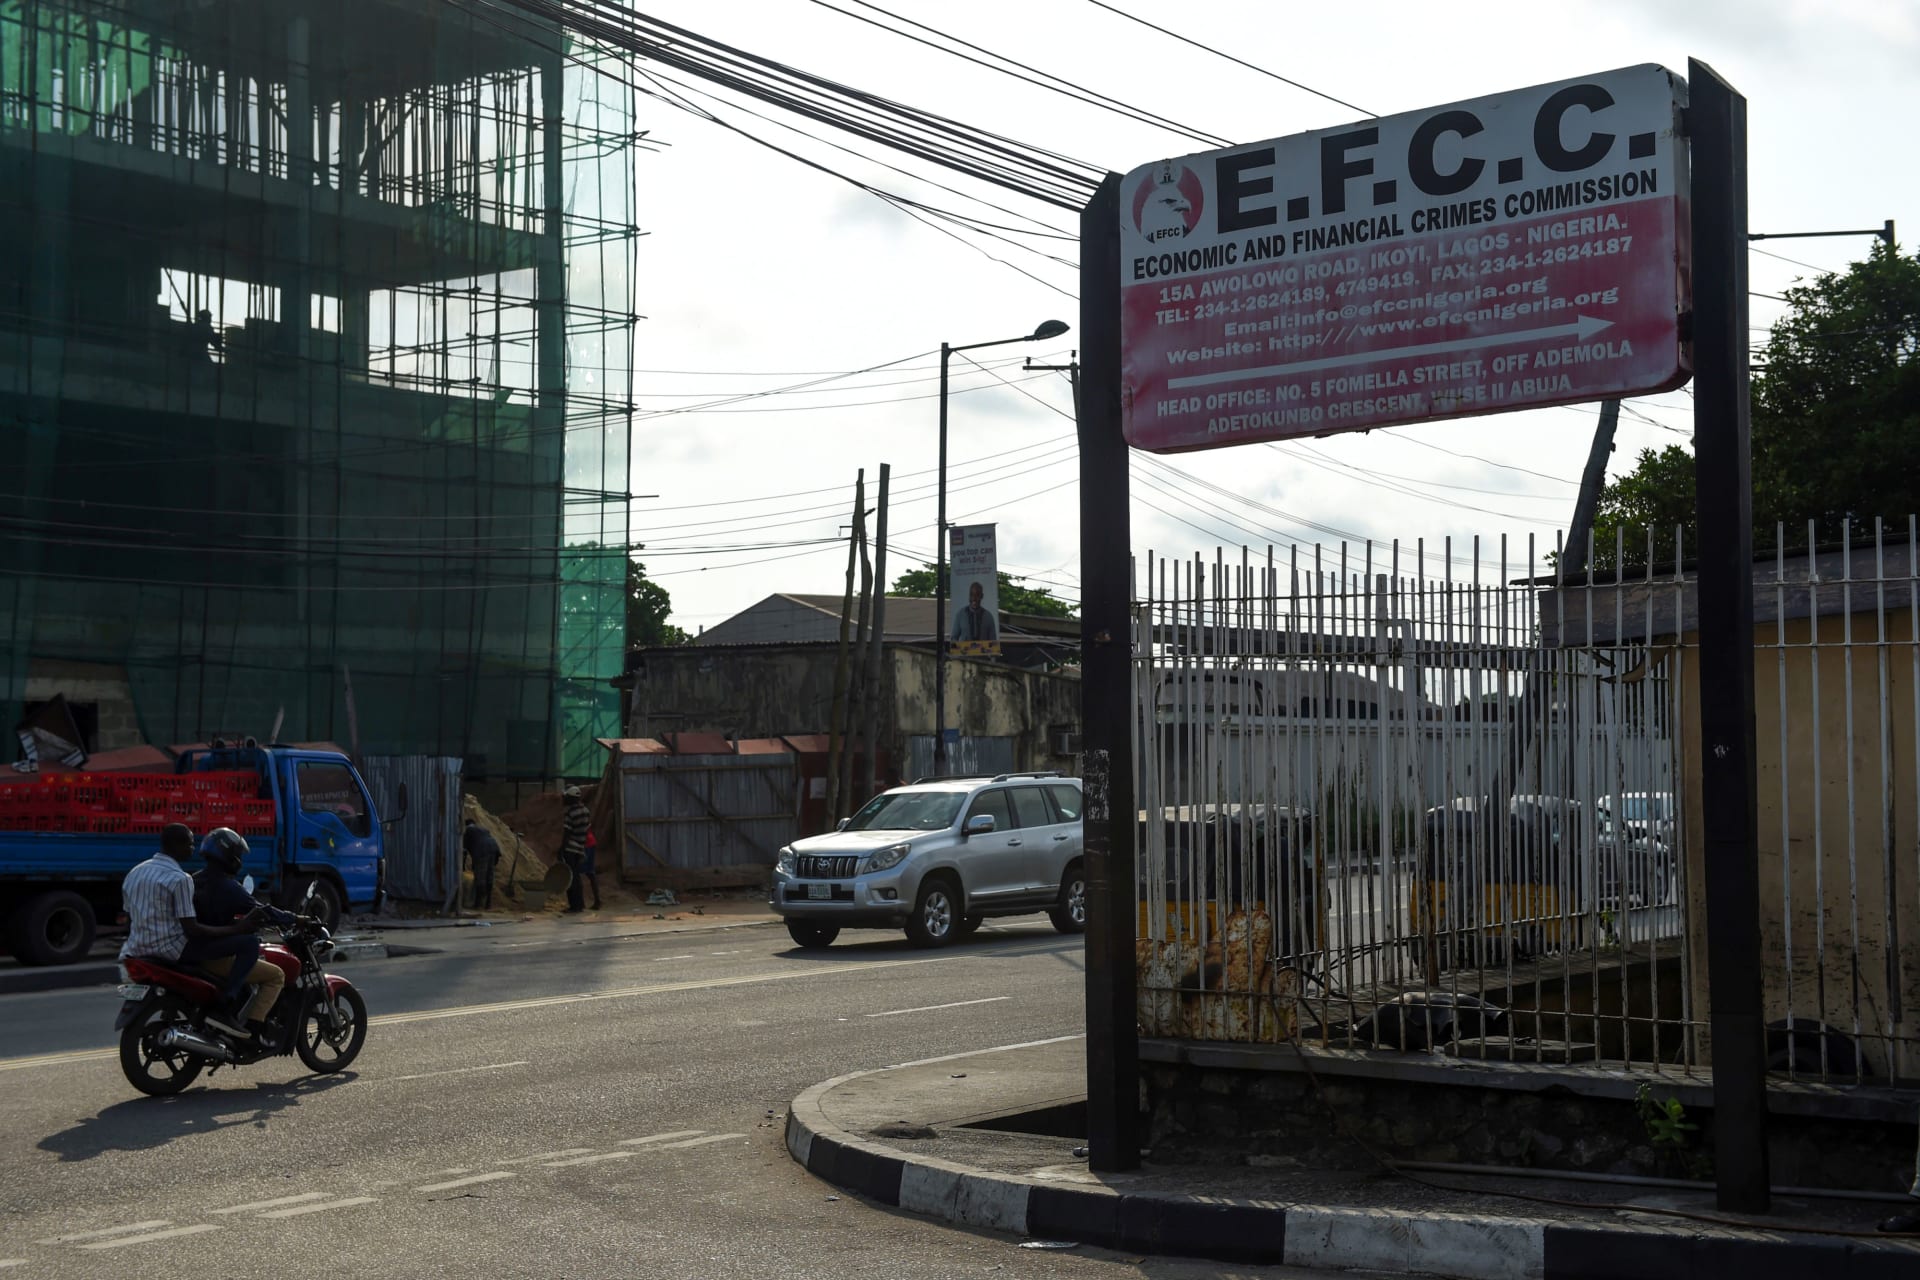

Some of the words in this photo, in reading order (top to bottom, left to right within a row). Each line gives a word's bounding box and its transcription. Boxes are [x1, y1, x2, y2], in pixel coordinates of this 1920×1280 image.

[1215, 83, 1657, 234] E.F.C.C.
[1134, 242, 1237, 280] ECONOMIC
[1243, 234, 1286, 262] AND
[1293, 214, 1404, 254] FINANCIAL
[1411, 198, 1497, 233] CRIMES
[1504, 168, 1657, 218] COMMISSION
[1156, 227, 1180, 240] EFCC
[1159, 284, 1196, 304] 15A
[1200, 267, 1299, 298] AWOLOWO
[1304, 257, 1365, 281] ROAD,
[1370, 245, 1431, 270] IKOYI,
[1438, 232, 1510, 258] LAGOS
[1527, 213, 1628, 245] NIGERIA.
[1155, 308, 1190, 326] TEL:
[1194, 285, 1330, 320] 234-1-2624189,
[1335, 271, 1420, 297] 4749419.
[1431, 261, 1476, 283] FAX:
[1480, 235, 1633, 275] 234-1-2624187
[1157, 397, 1201, 417] HEAD
[1206, 388, 1270, 411] OFFICE:
[1276, 384, 1305, 403] NO.
[1310, 381, 1321, 397] 5
[1326, 370, 1408, 396] FOMELLA
[1413, 359, 1487, 384] STREET,
[1492, 353, 1529, 374] OFF
[1533, 340, 1633, 369] ADEMOLA
[1167, 341, 1262, 365] Website:
[1207, 406, 1323, 435] ADETOKUNBO
[1431, 384, 1486, 411] WUSE
[1491, 382, 1504, 400] II
[1510, 374, 1573, 398] ABUJA
